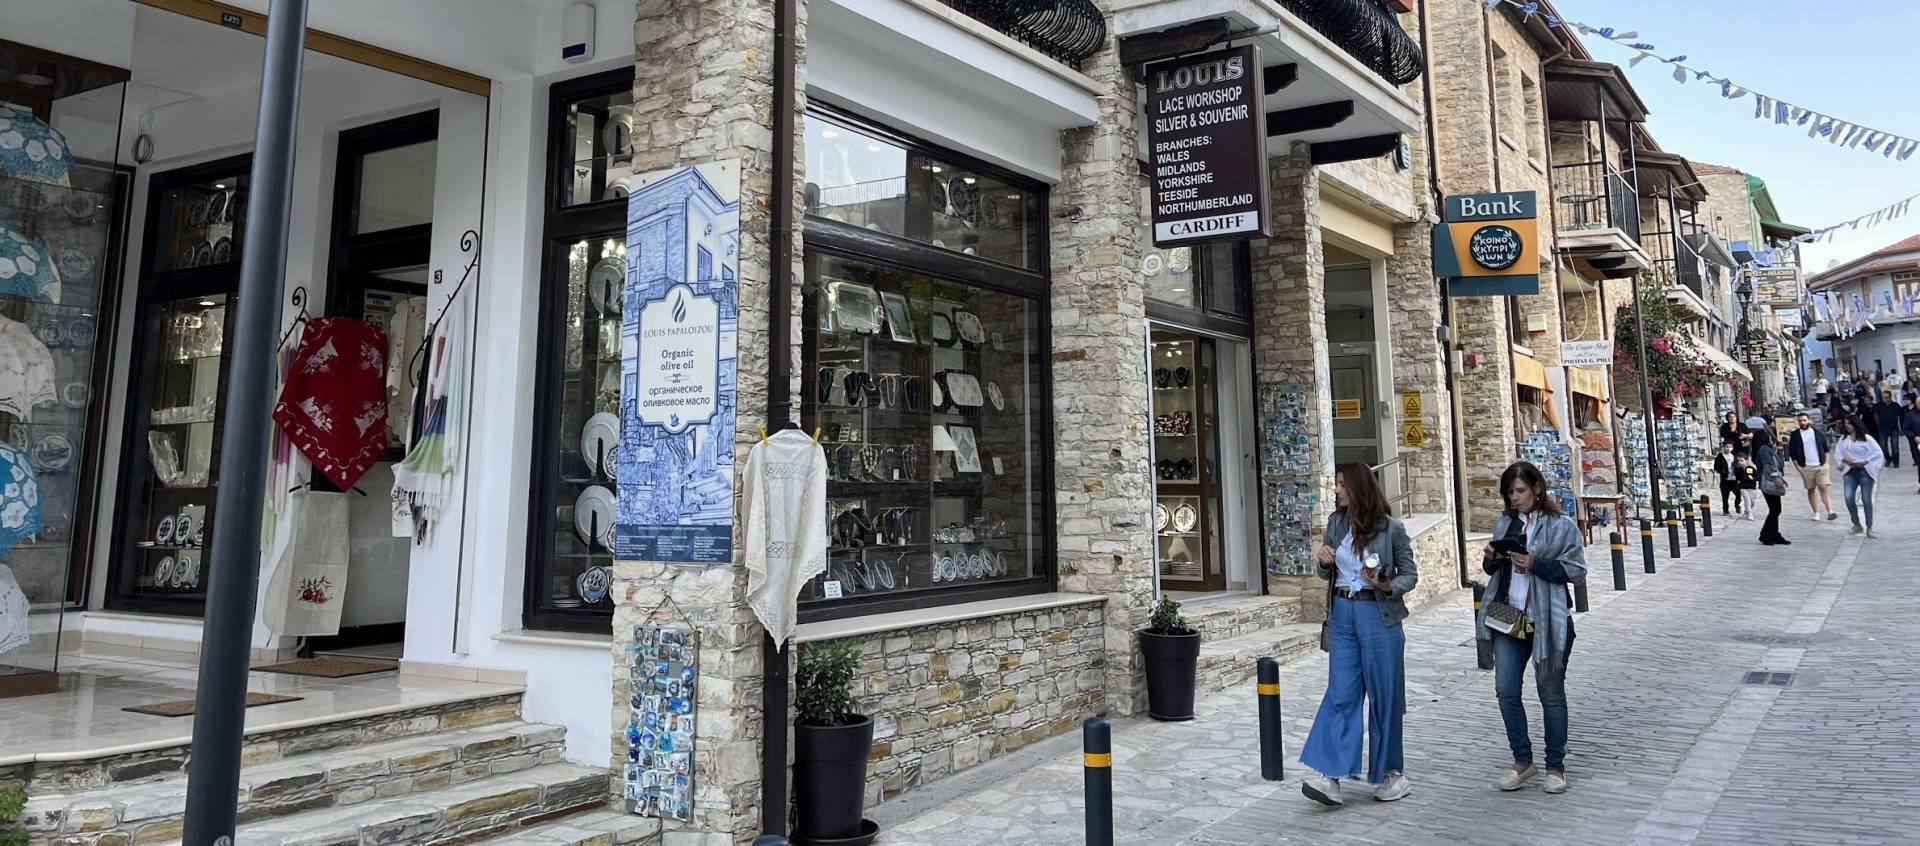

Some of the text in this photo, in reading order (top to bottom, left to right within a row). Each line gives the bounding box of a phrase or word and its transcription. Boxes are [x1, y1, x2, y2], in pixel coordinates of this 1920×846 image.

[1156, 56, 1244, 93] LOUIS
[1159, 85, 1243, 114] LACE WORKSHOP
[1155, 104, 1249, 134] SILVER & SOUVENIR
[1156, 135, 1213, 153] BRANCHES:
[1157, 150, 1190, 165] WALES
[1157, 161, 1206, 177] MIDLANDS
[1158, 172, 1213, 189] YORKSHIRE
[1158, 187, 1198, 202] TEESIDE
[1158, 193, 1253, 215] NORTHUMBERLAND
[1460, 195, 1523, 217] Bank
[1170, 215, 1245, 236] CARDIFF
[644, 325, 714, 338] LOUIS PAPALOIZOU
[661, 348, 694, 360] Organic
[660, 360, 694, 371] olive oil
[649, 385, 703, 397] органическое
[643, 397, 711, 408] оливковое масло
